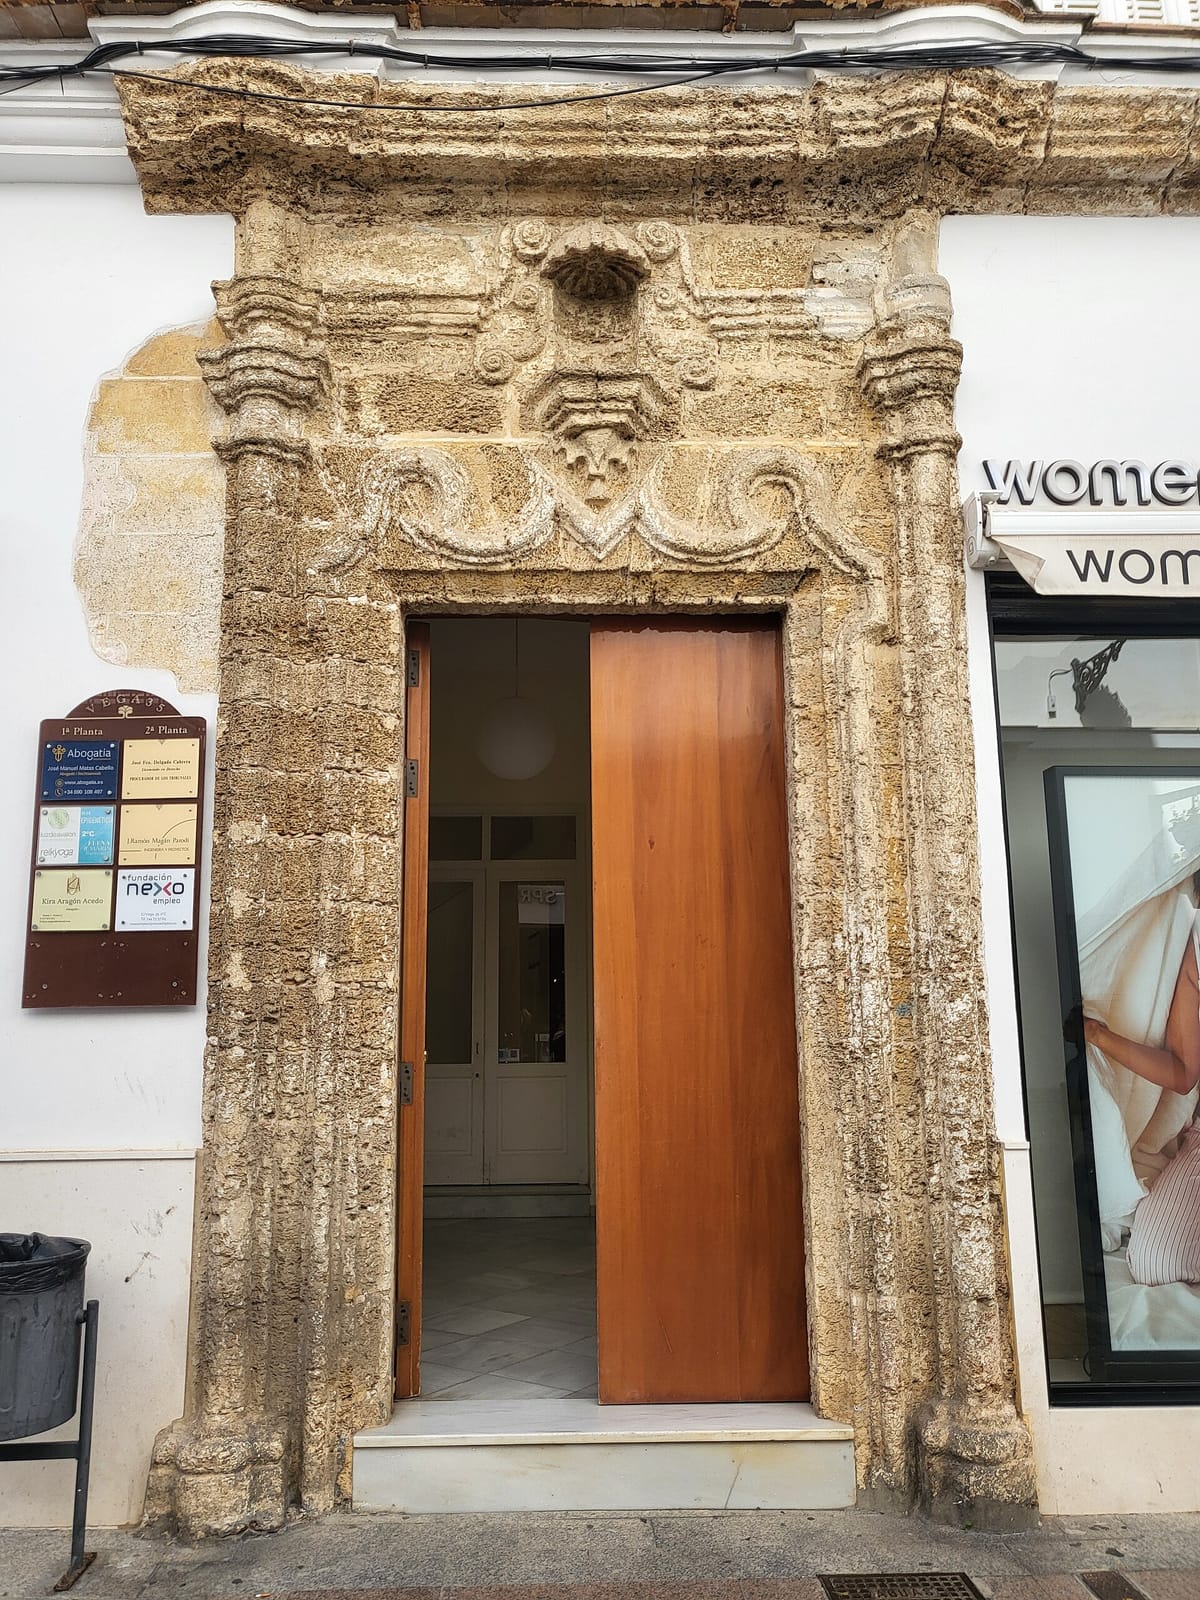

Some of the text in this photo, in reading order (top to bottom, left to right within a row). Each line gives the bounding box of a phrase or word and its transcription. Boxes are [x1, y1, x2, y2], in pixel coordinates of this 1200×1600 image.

[982, 459, 1200, 506] wome
[73, 727, 103, 735] Planta
[158, 726, 188, 734] Planta
[127, 873, 172, 881] fundación
